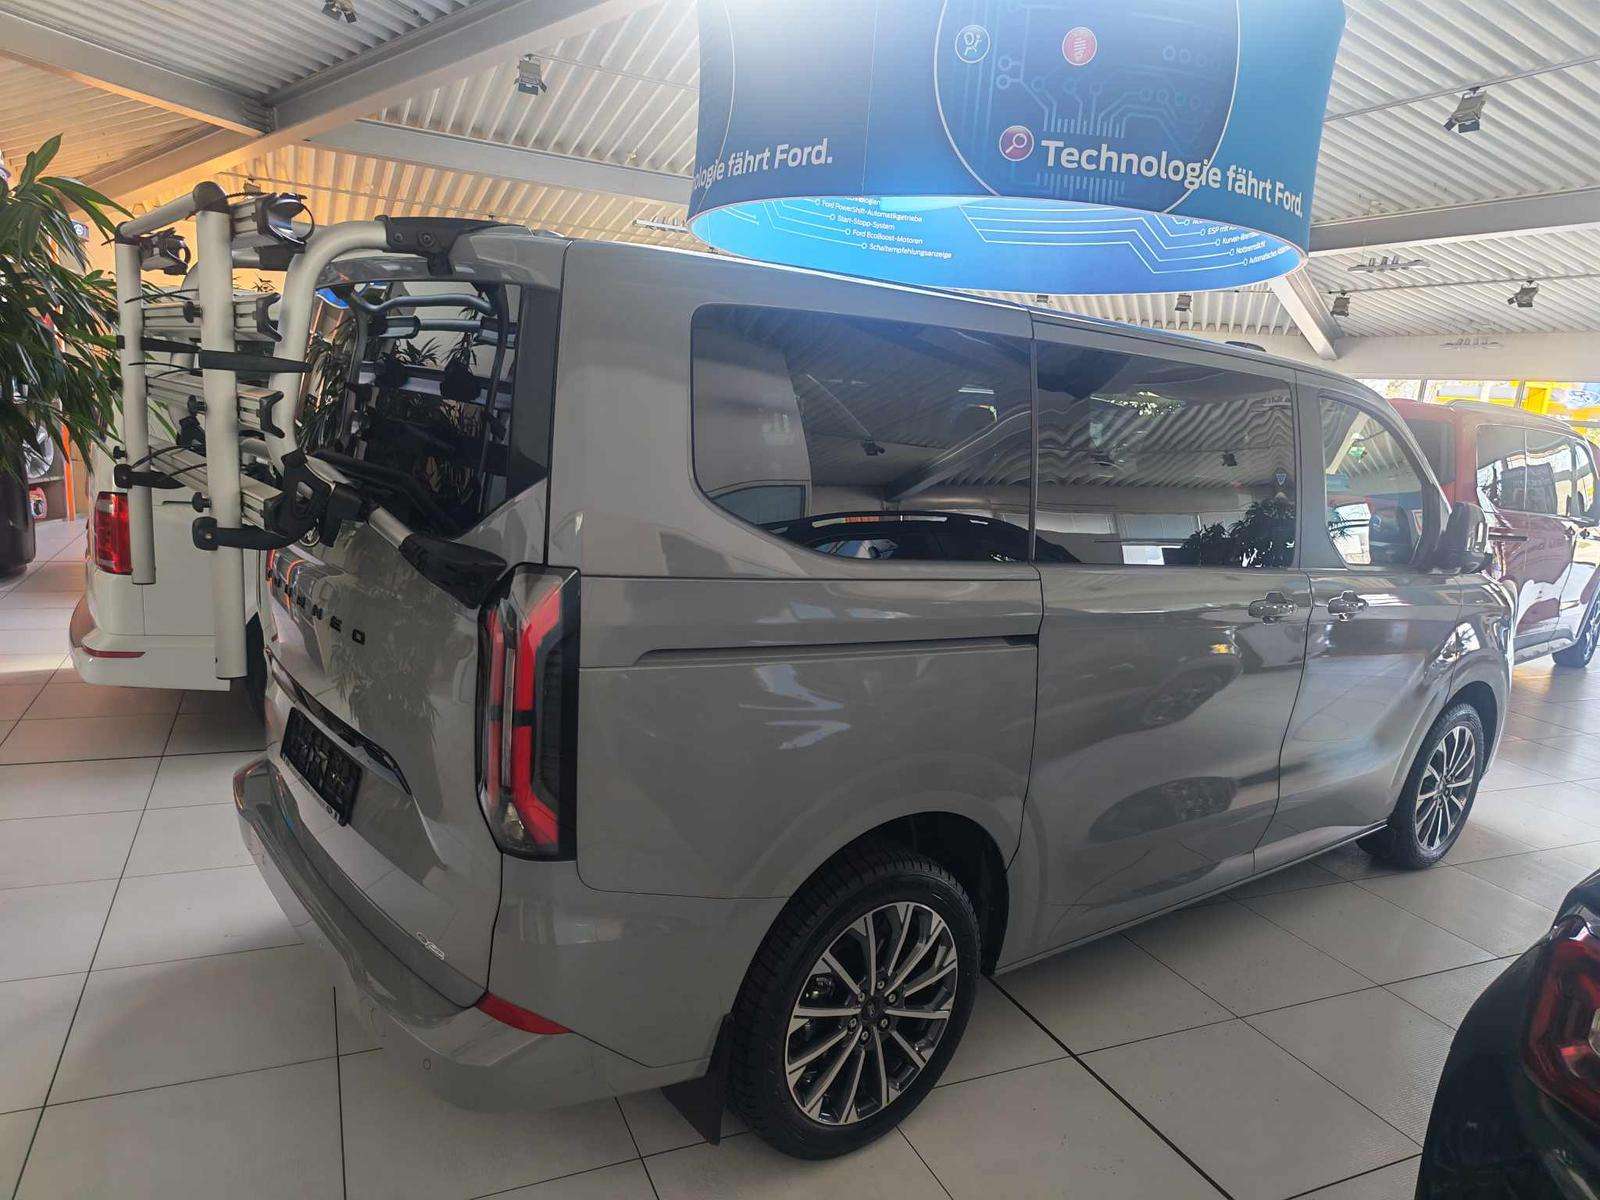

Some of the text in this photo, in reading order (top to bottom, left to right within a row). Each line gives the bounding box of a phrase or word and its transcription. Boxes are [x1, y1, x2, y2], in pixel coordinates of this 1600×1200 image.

[727, 147, 771, 178] fährt
[773, 136, 833, 170] Ford.
[1041, 139, 1304, 219] Technologie fährt Ford.
[852, 229, 866, 238] Ford
